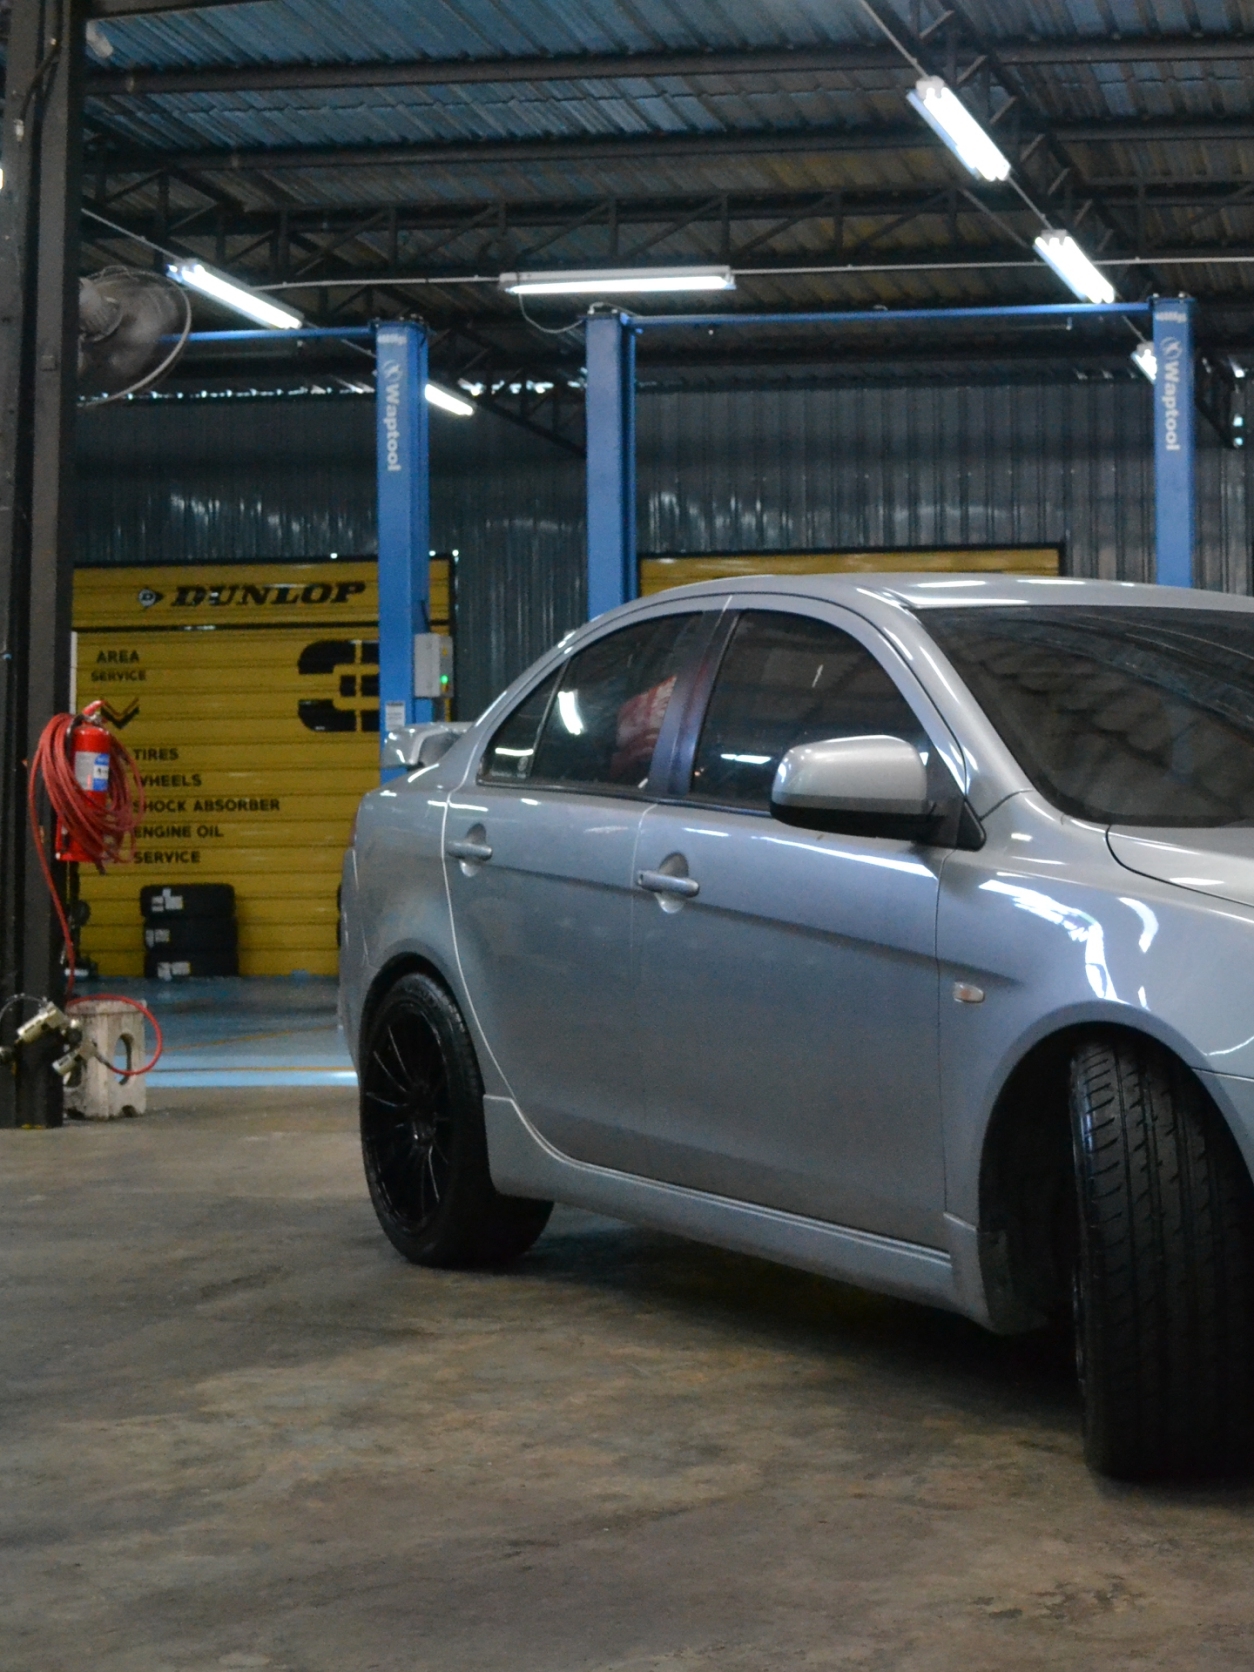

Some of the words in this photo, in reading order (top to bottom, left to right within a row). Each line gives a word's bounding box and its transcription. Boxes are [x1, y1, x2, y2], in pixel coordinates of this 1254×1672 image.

[1156, 361, 1181, 450] Waptool
[384, 383, 401, 471] Waptool
[172, 582, 366, 606] DUNLOP
[96, 650, 140, 664] AREA
[90, 669, 147, 682] SERVICE
[134, 748, 179, 761] TIRES
[193, 798, 281, 812] ABSORBER
[134, 825, 192, 839] ENGINE
[197, 825, 225, 839] OIL
[134, 851, 200, 864] SERVICE
